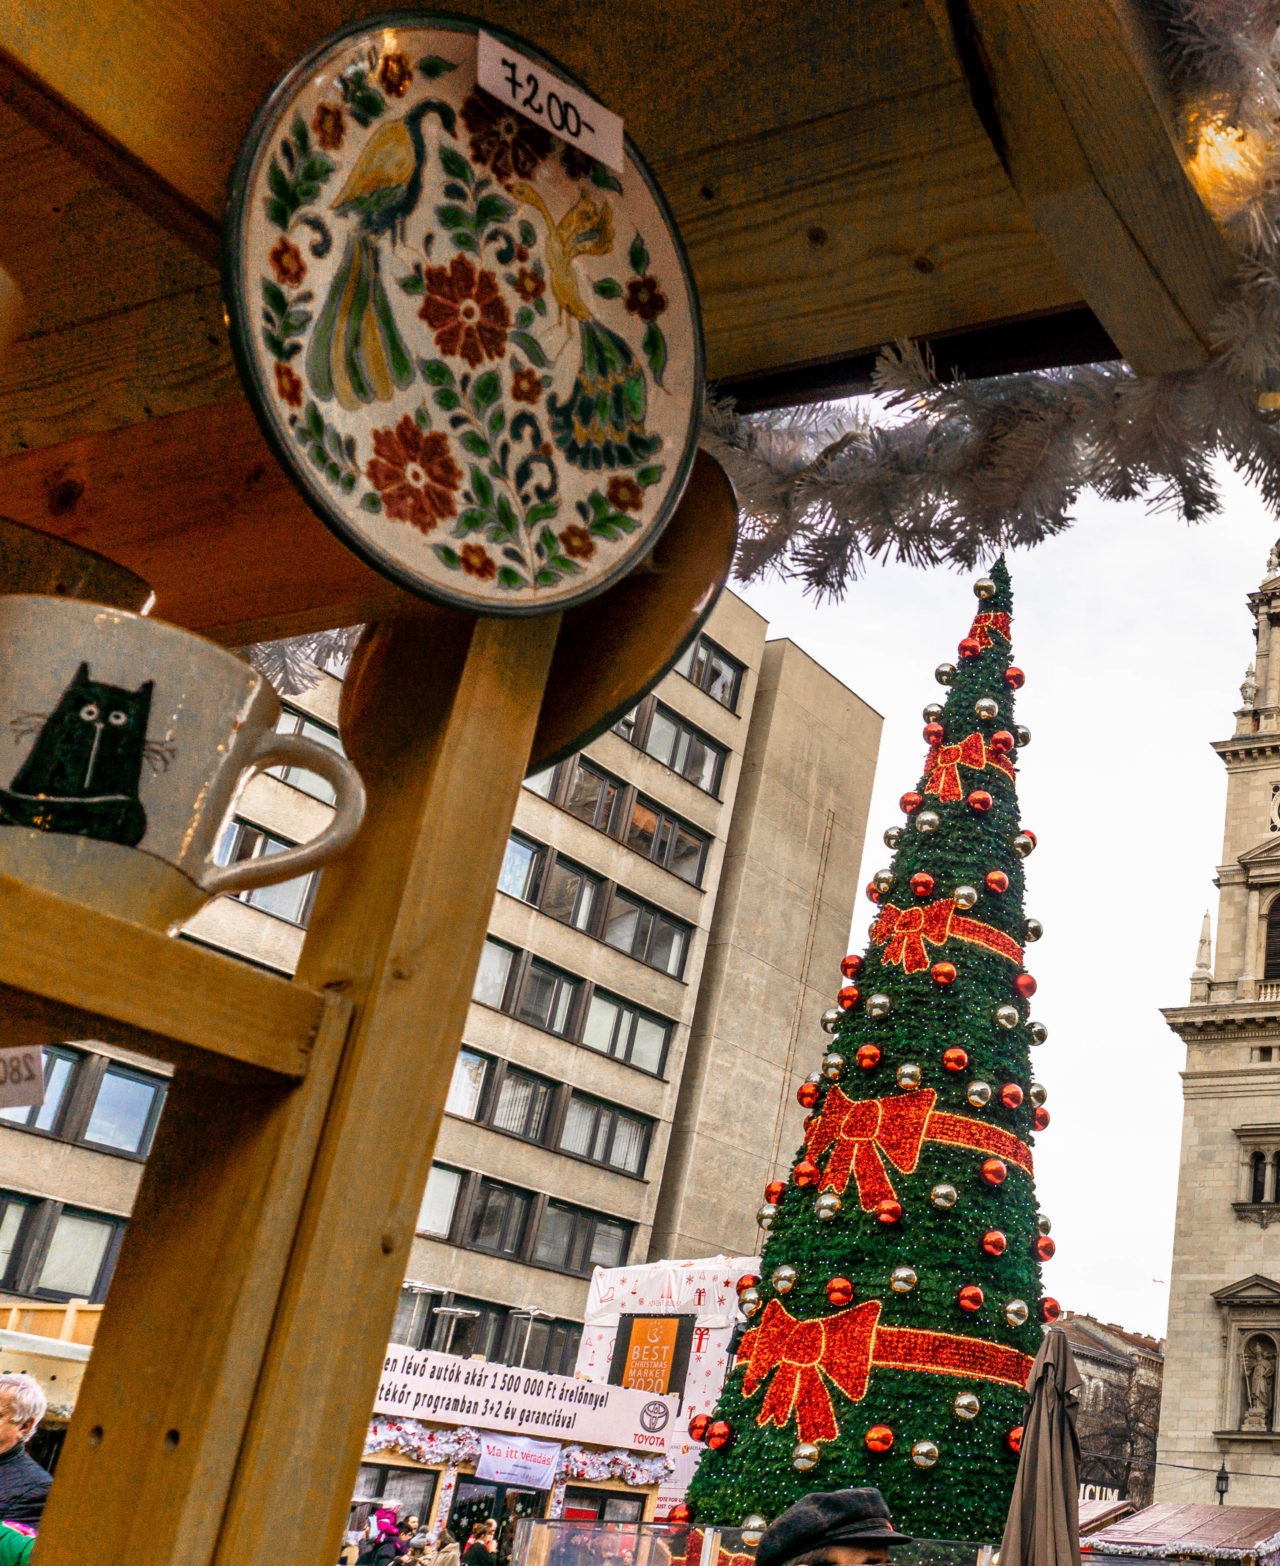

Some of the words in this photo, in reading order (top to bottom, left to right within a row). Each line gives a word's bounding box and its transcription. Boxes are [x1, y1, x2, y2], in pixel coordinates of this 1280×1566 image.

[631, 1345, 670, 1361] BEST
[630, 1360, 668, 1369] CHRISTMAS
[628, 1368, 667, 1378] MARKET
[400, 1354, 429, 1377] lévő
[429, 1362, 462, 1383] autók
[463, 1367, 489, 1387] akár
[491, 1372, 498, 1389] 1
[500, 1373, 521, 1393] 500
[523, 1377, 544, 1397] 000
[545, 1381, 557, 1399] Ft
[558, 1382, 610, 1411] árelőnnyel
[628, 1378, 665, 1394] 2020
[412, 1391, 479, 1415] programban
[481, 1398, 502, 1418] 3+2
[504, 1400, 517, 1420] év
[517, 1408, 577, 1429] garanciával
[632, 1433, 666, 1447] TOYOTA
[486, 1444, 502, 1457] Ma
[505, 1446, 518, 1459] itt
